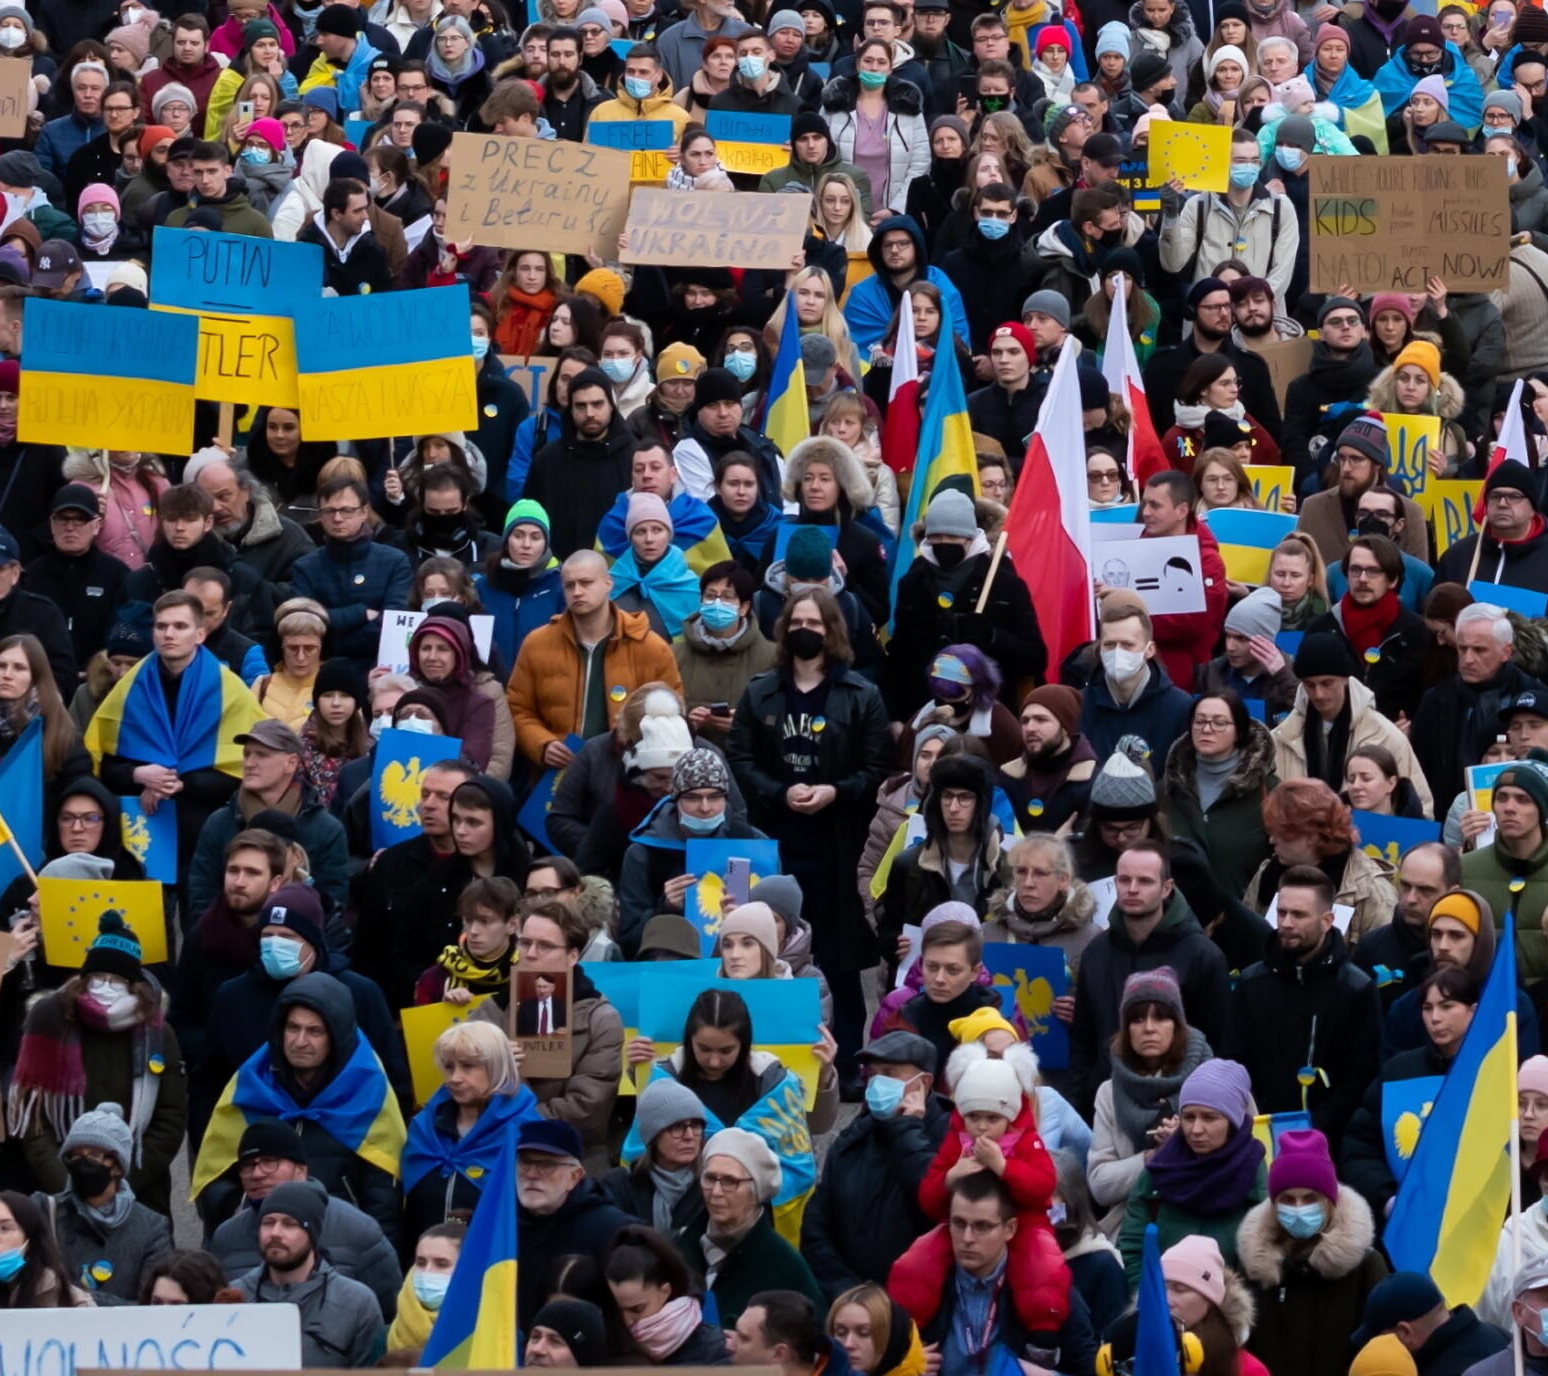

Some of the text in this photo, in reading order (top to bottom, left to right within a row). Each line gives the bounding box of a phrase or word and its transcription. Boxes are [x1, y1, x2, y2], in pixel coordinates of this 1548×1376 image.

[605, 125, 655, 149] FREE
[1313, 198, 1378, 237] KIDS
[1428, 204, 1502, 237] MISSILES
[184, 234, 275, 290] PUTIN
[1391, 253, 1506, 289] ACT NOW!
[198, 330, 282, 383] TLER
